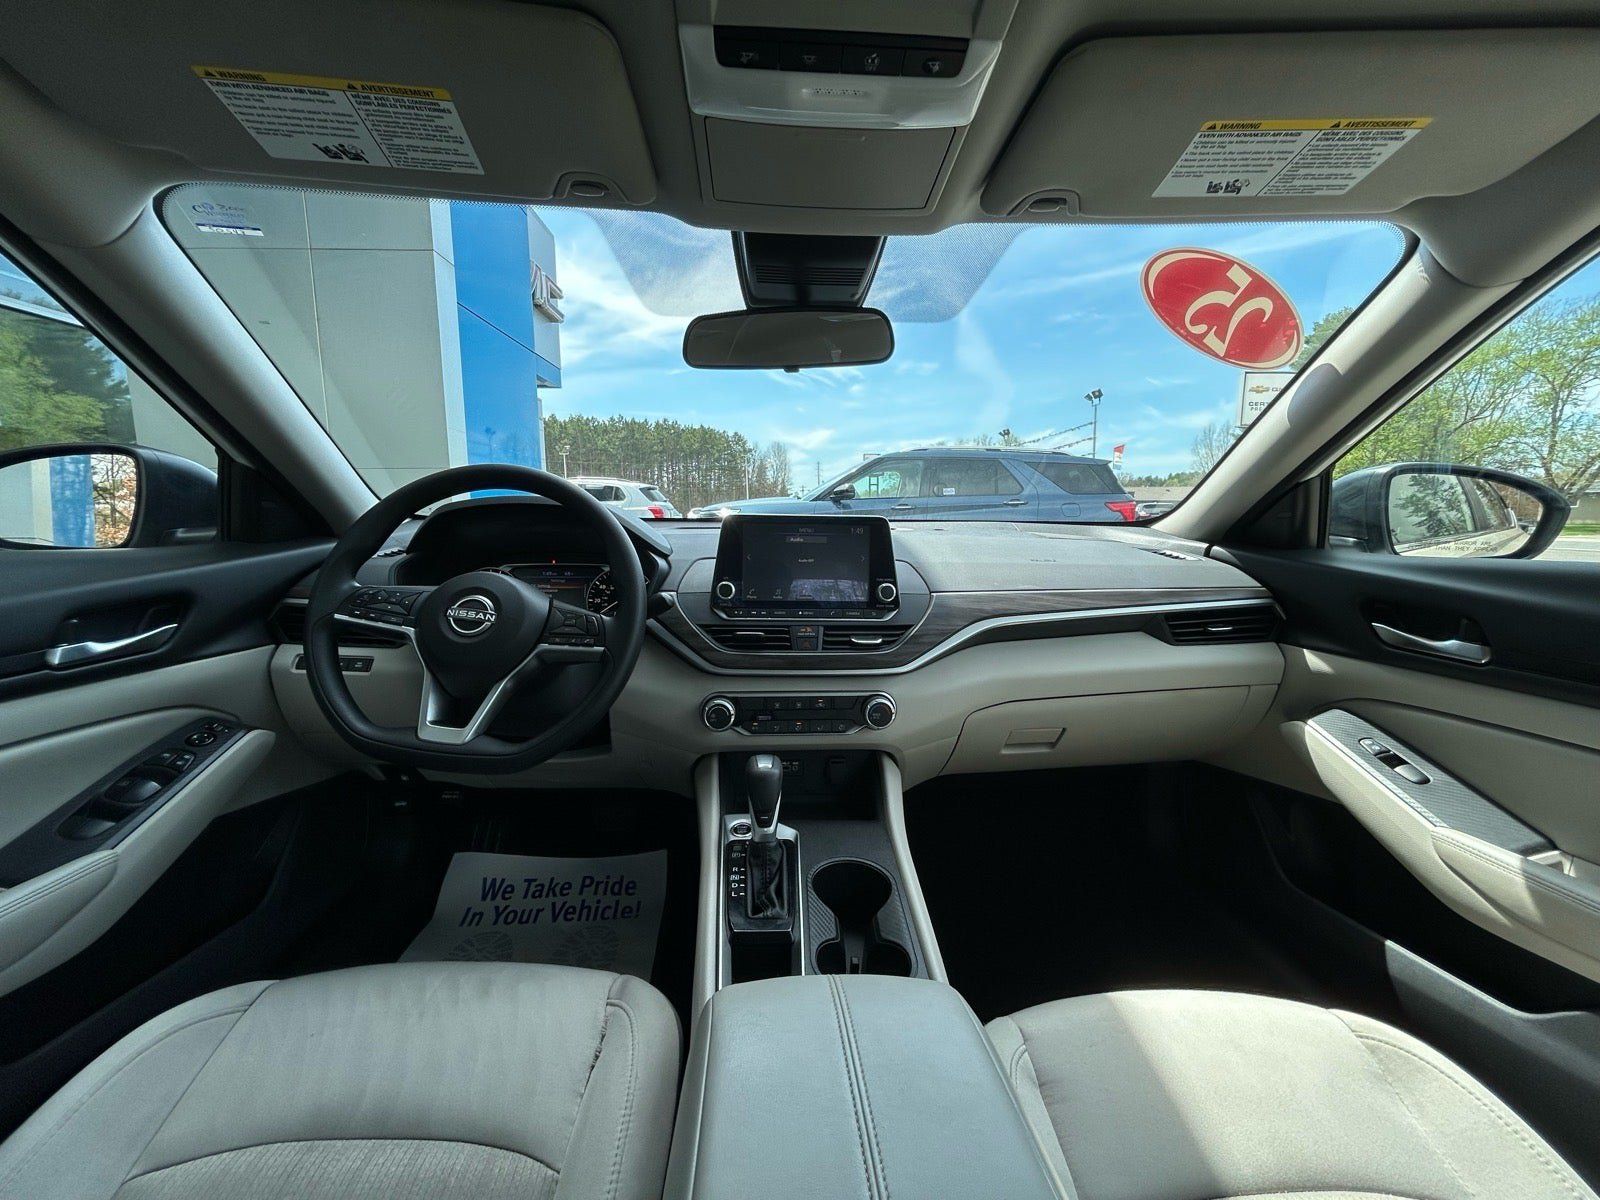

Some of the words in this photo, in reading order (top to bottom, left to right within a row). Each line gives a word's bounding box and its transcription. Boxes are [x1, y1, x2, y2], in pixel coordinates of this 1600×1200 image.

[215, 70, 267, 81] WARNING
[360, 83, 435, 98] AVERTISSEMENT
[1219, 121, 1262, 130] WARNING
[1343, 120, 1417, 128] AVERTISSEMENT
[447, 608, 496, 624] NISSAN
[480, 876, 515, 901] We
[522, 876, 573, 900] Take
[578, 875, 637, 897] Pride
[458, 906, 484, 927] In
[491, 904, 544, 927] Your
[550, 900, 642, 924] Vehicle!
